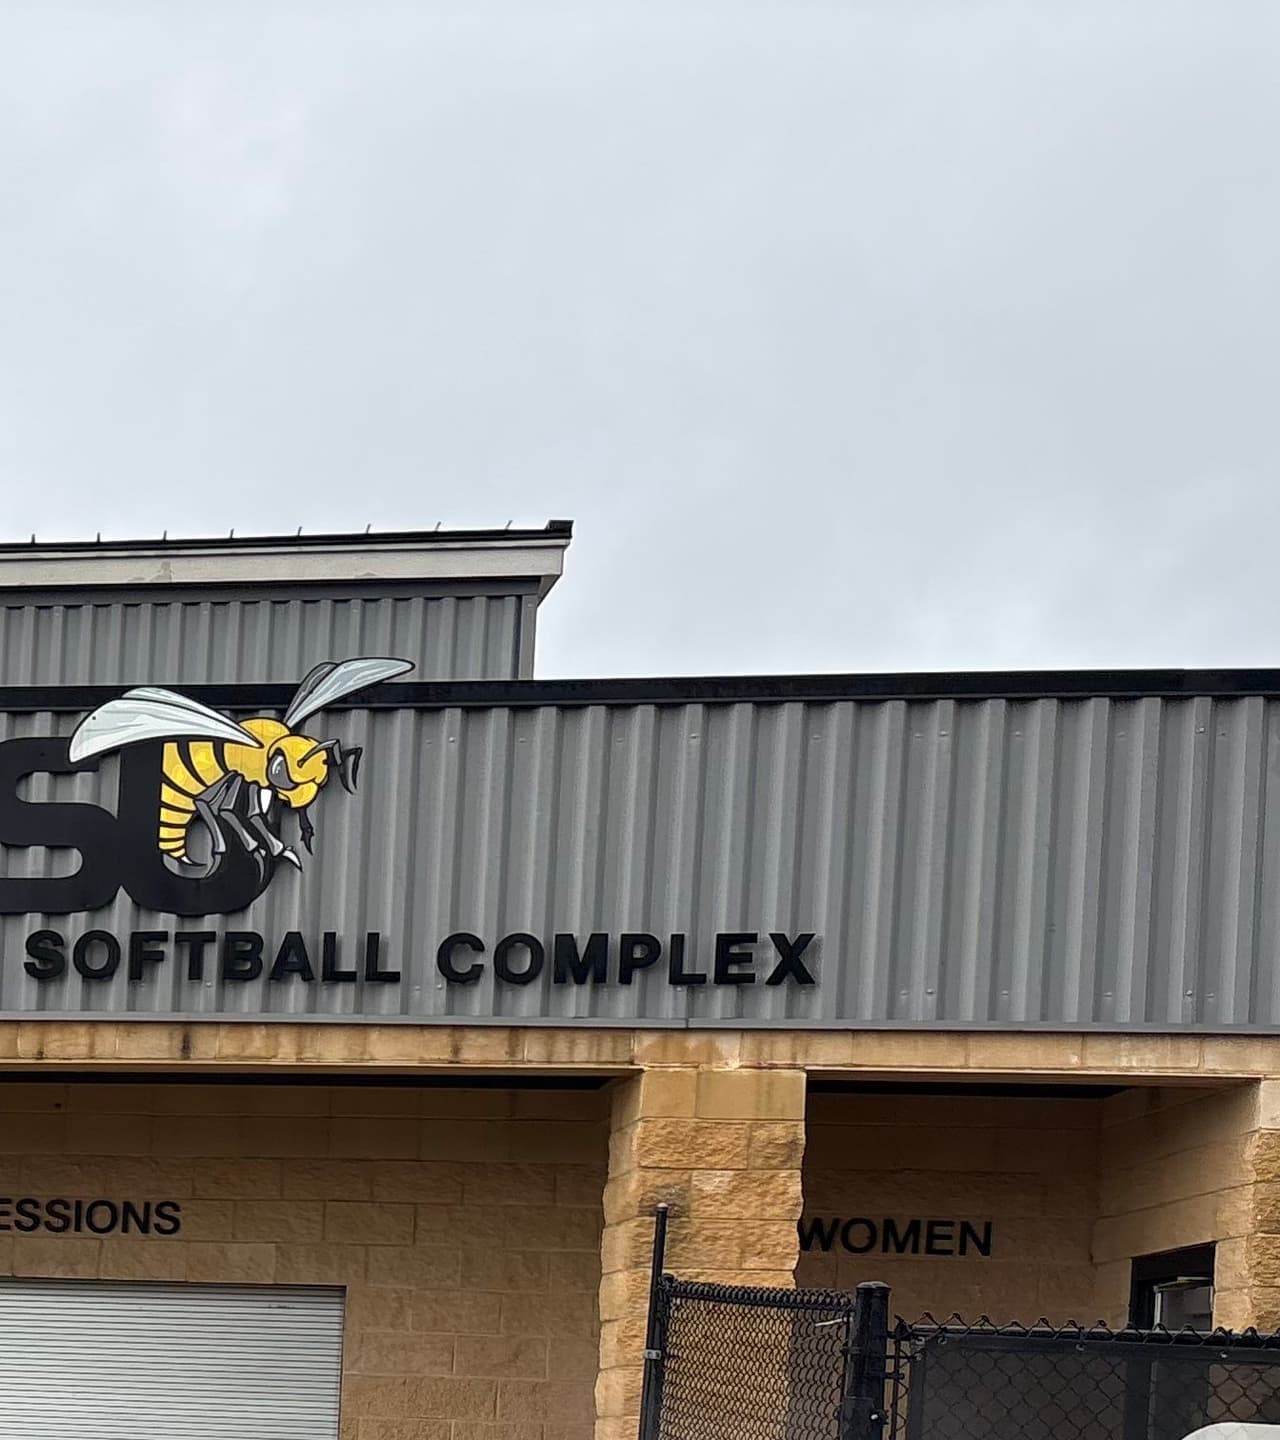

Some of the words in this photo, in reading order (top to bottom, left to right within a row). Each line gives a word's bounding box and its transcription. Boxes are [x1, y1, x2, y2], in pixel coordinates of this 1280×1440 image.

[23, 929, 401, 984] SOFTBALL
[436, 931, 818, 987] COMPLEX
[797, 1216, 993, 1257] WOMEN
